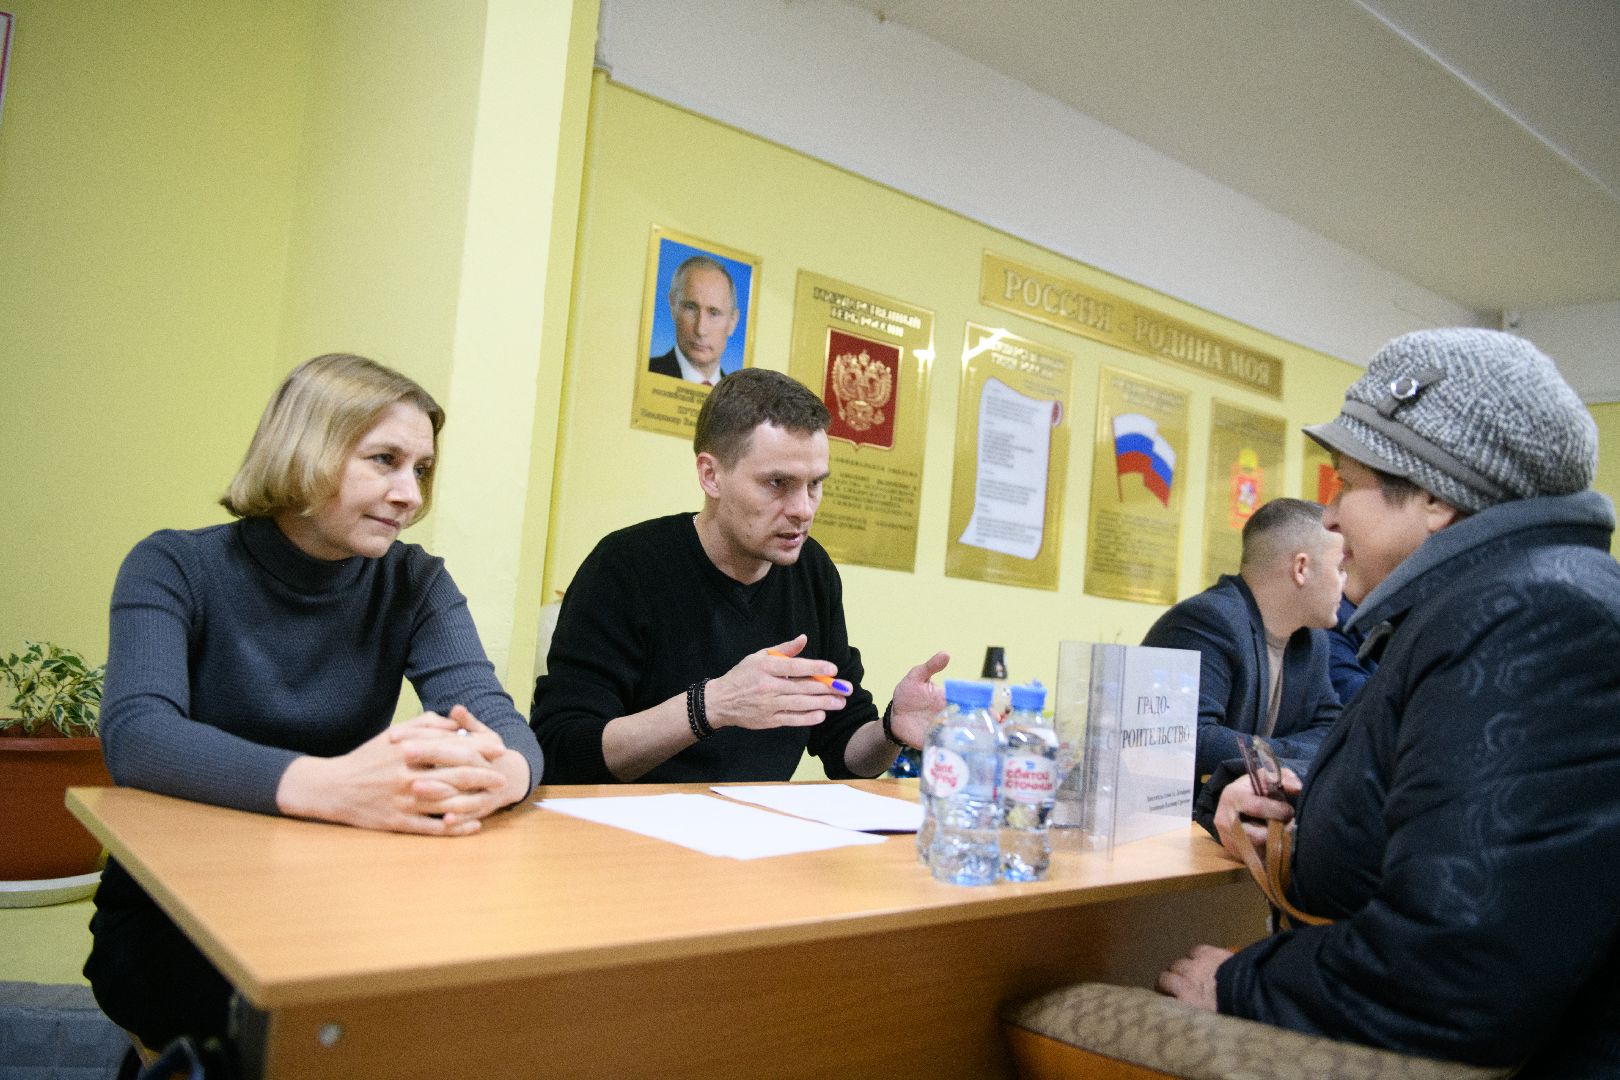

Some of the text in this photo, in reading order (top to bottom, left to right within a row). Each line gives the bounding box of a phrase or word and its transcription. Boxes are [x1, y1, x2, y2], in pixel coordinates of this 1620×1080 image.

[1003, 267, 1112, 333] РОССИЯ
[1133, 315, 1223, 371] РОДИНА
[1229, 350, 1271, 387] МОЯ
[1136, 695, 1170, 715] ГРАДО-
